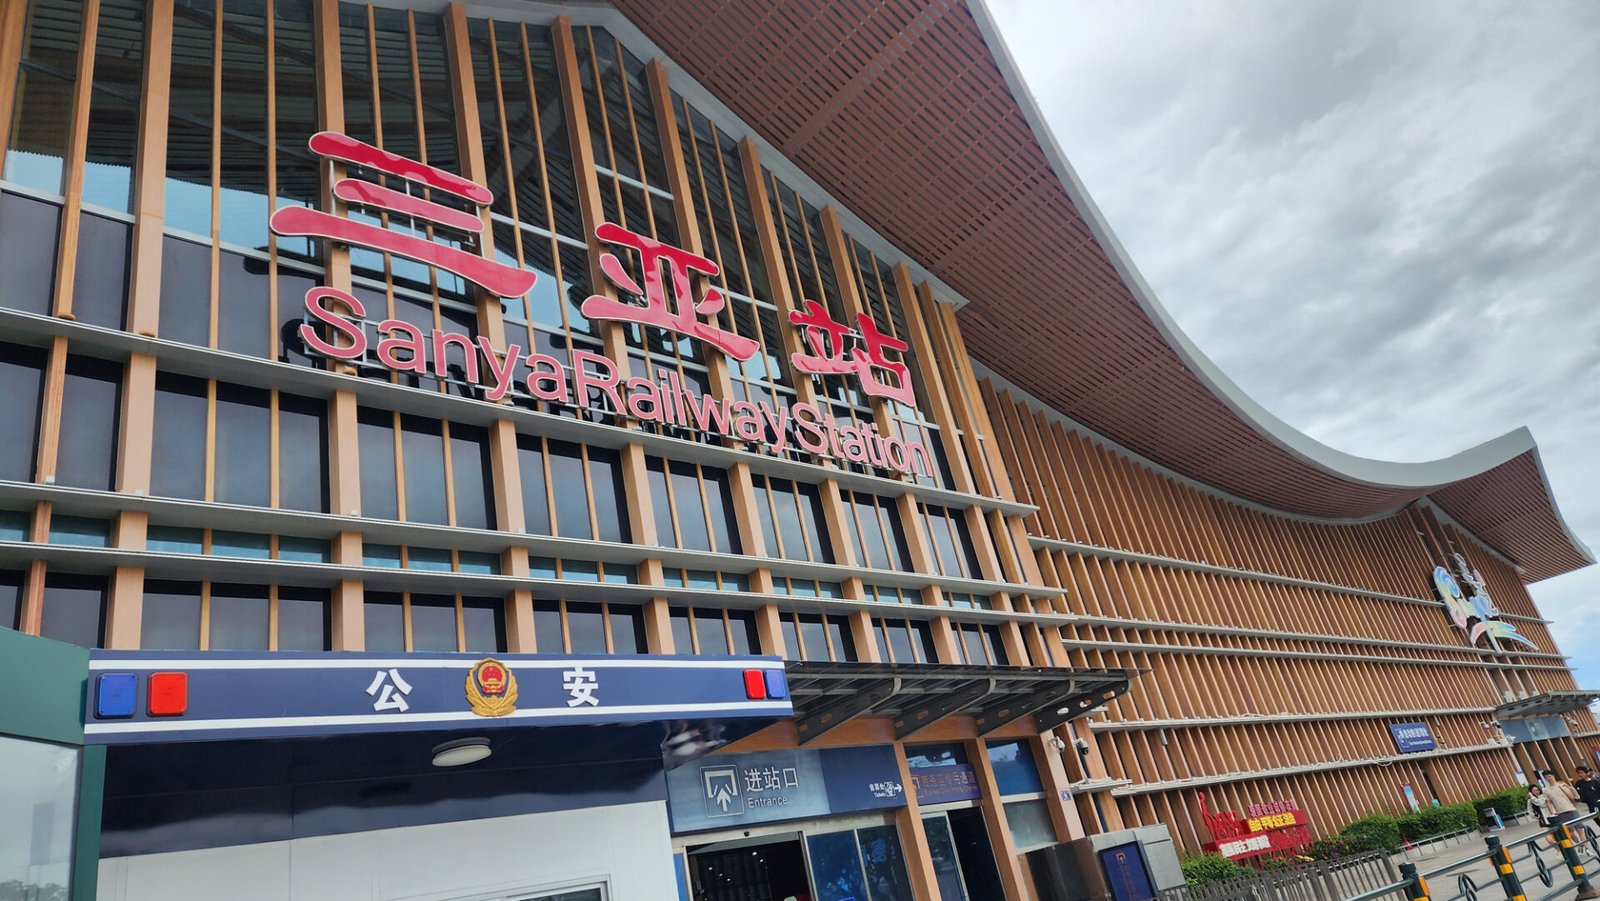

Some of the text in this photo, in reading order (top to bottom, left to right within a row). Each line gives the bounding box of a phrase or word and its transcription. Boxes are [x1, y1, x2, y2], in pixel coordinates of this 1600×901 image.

[270, 131, 916, 407] 三亚站
[744, 766, 799, 792] 进站口
[747, 796, 789, 809] Entrance
